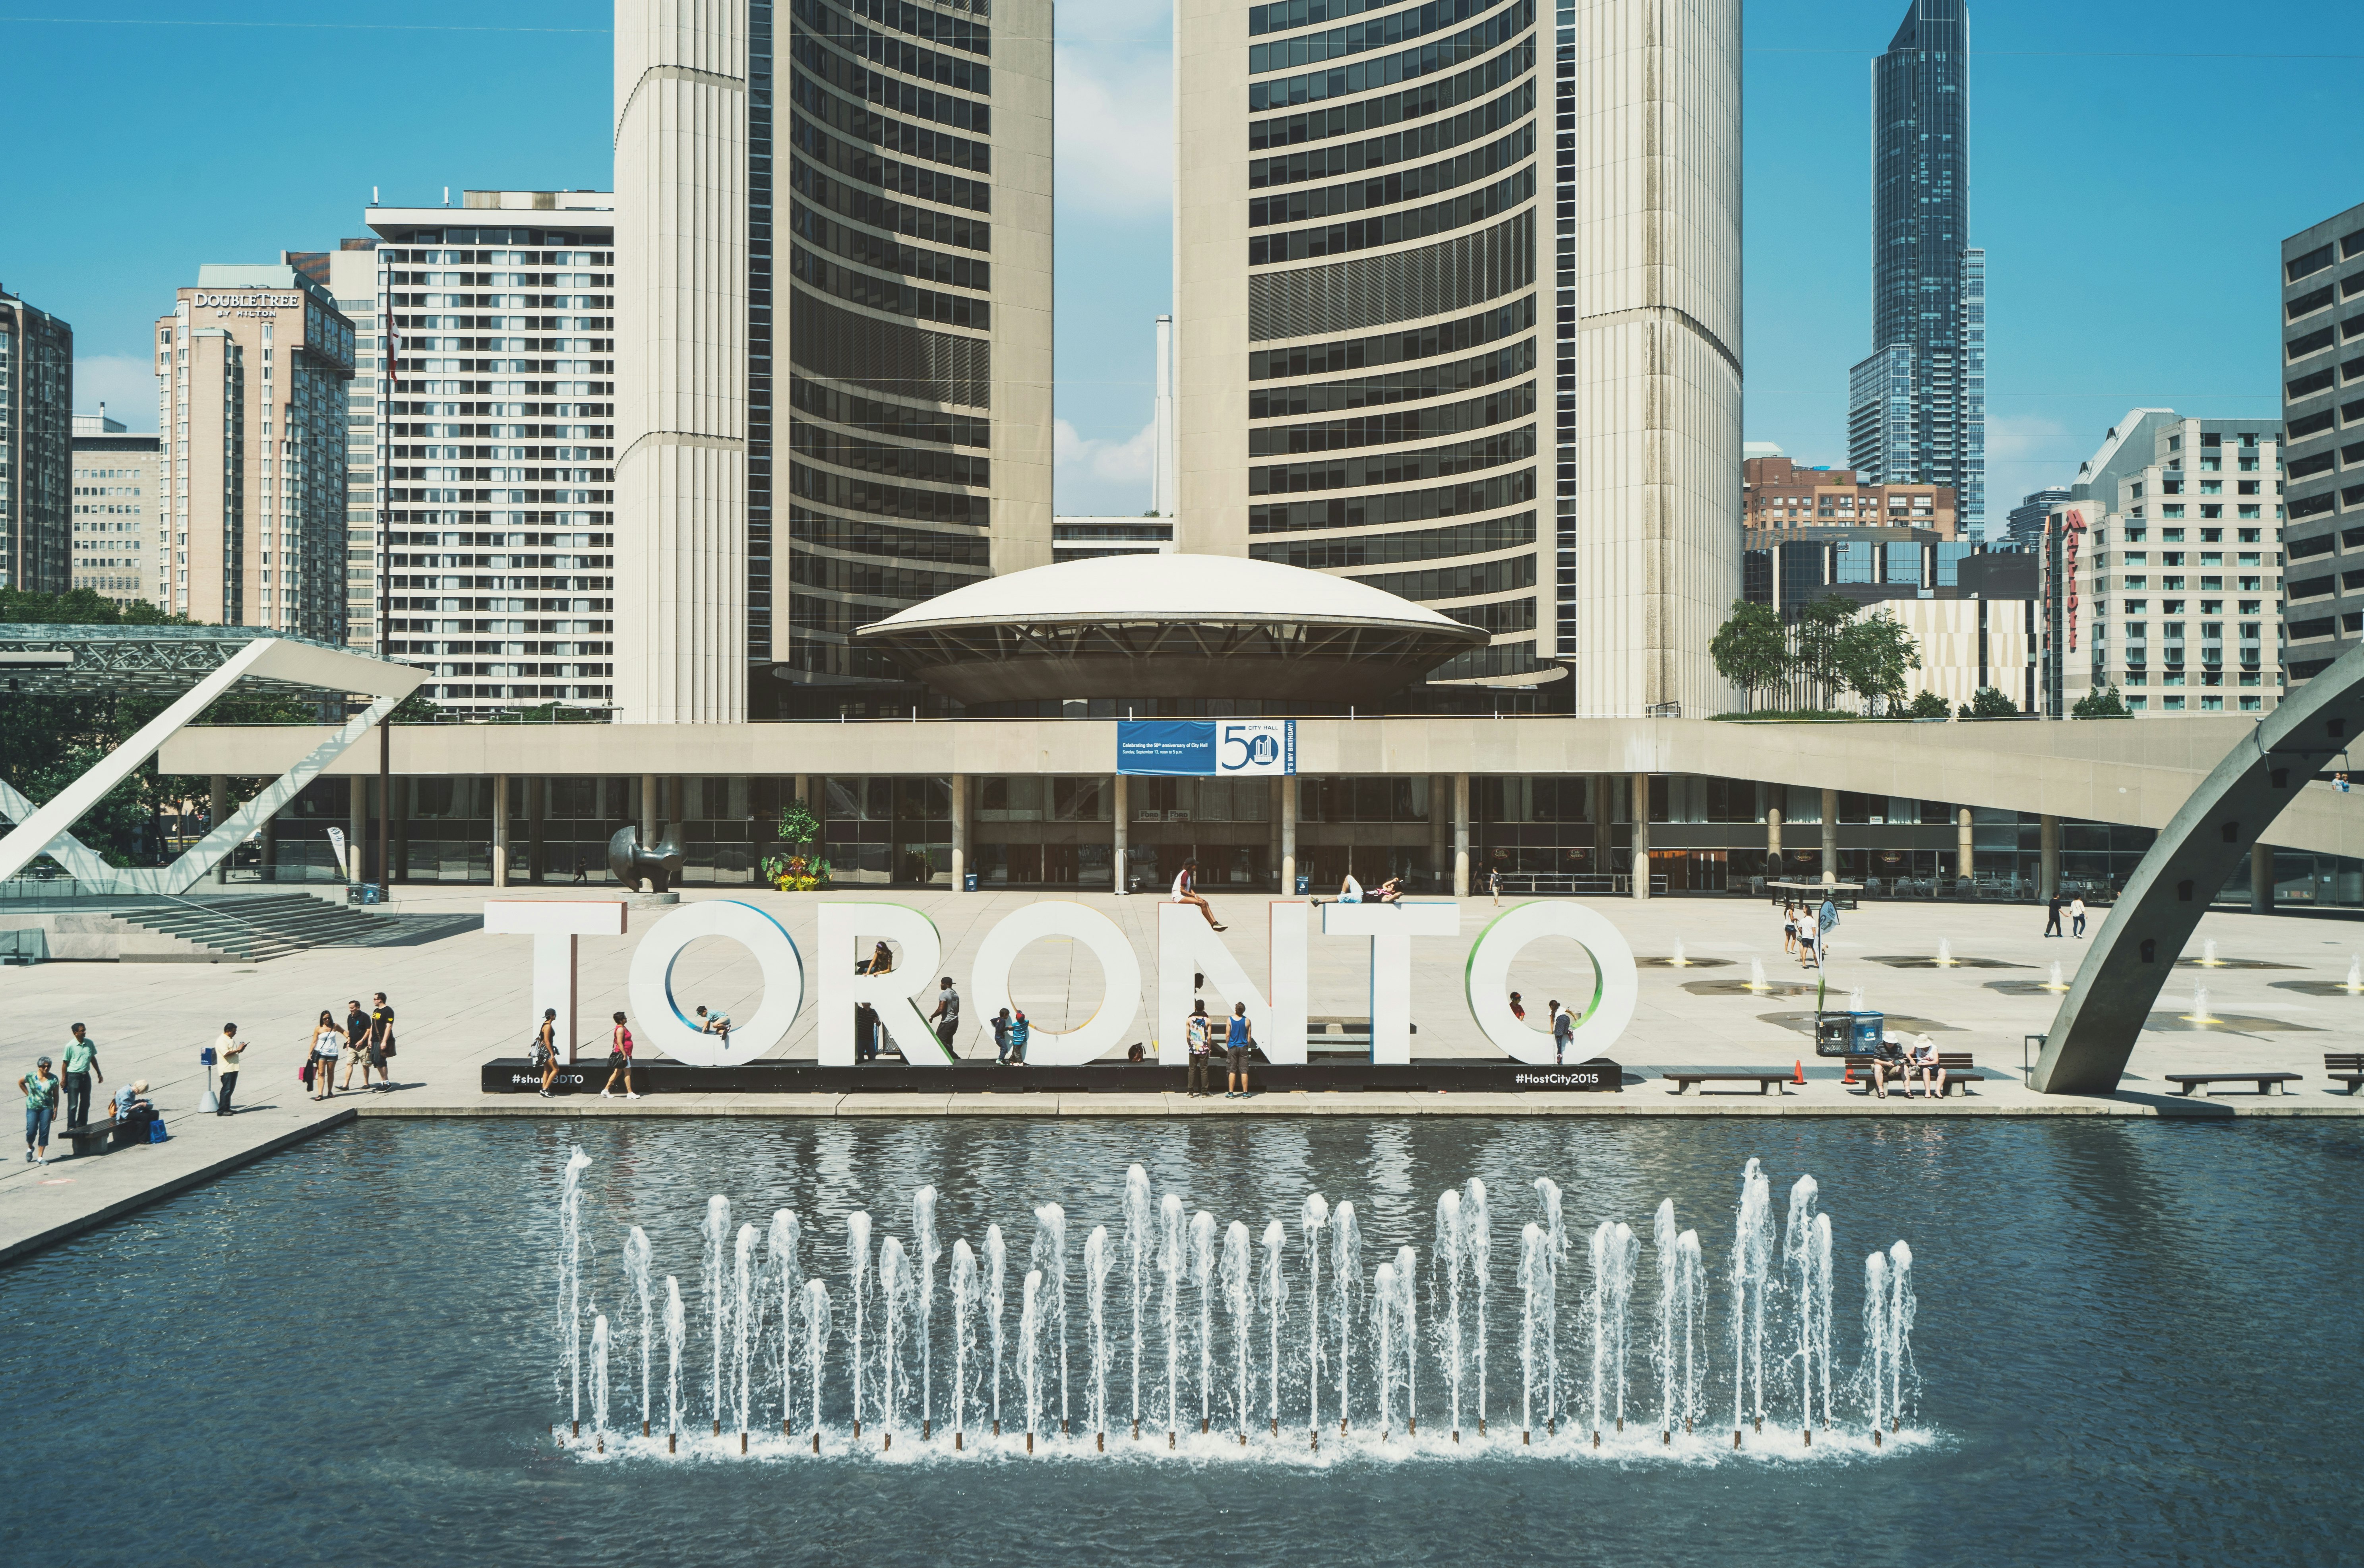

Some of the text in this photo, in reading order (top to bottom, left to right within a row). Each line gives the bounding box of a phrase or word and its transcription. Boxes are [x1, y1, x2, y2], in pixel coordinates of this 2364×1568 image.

[2062, 509, 2087, 648] Marriott
[1288, 753, 1293, 762] MY
[484, 900, 1638, 1066] TORONTO
[1516, 1074, 1599, 1085] #HostCity2015
